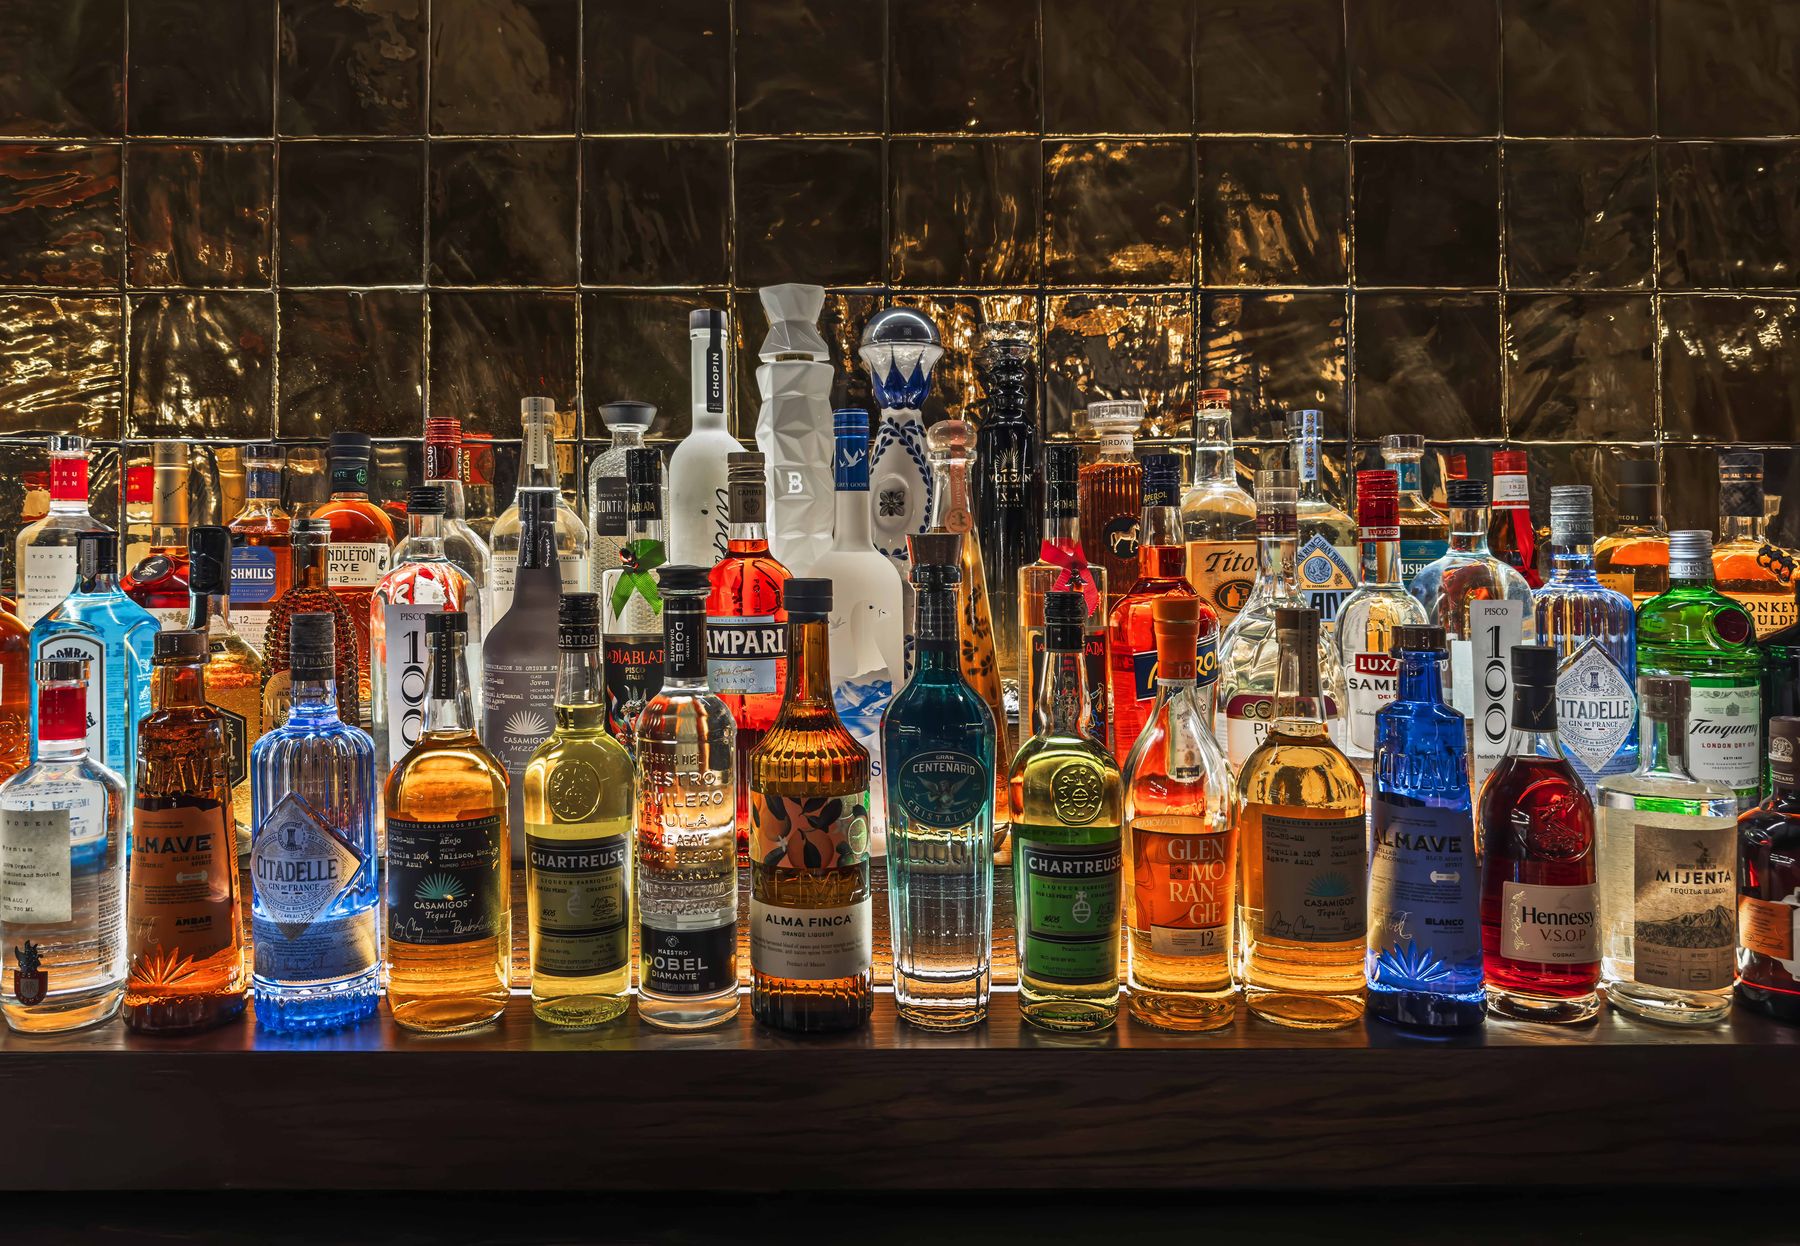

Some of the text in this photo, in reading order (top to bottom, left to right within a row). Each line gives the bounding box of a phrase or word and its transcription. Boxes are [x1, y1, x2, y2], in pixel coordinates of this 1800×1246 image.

[712, 352, 720, 398] CHOPIN
[787, 471, 803, 494] B
[1368, 527, 1399, 536] LUXARDO
[230, 567, 274, 580] SHMILLS
[330, 563, 360, 572] RYE
[339, 575, 349, 583] 12
[1483, 607, 1509, 616] PISCO
[239, 615, 249, 625] 12
[675, 621, 685, 673] DOBEL
[1591, 720, 1618, 728] FRANCE
[912, 761, 976, 776] CENTENARIO
[1167, 838, 1225, 861] GLEN
[530, 849, 625, 869] CHARTREUSE
[1027, 854, 1121, 875] CHARTREUSE
[257, 854, 339, 883] CITADELLE
[1191, 859, 1226, 881] MO
[1655, 868, 1733, 885] MIJENTA
[268, 883, 280, 891] GIN
[288, 883, 320, 892] FRANCE
[1169, 881, 1215, 903] RAN
[1669, 887, 1703, 895] TEQUILA
[413, 900, 468, 910] CASAMIGOS
[424, 911, 457, 921] Tequila
[765, 913, 852, 928] ALMA FINCA
[1189, 901, 1222, 925] GIE
[1521, 905, 1595, 928] Hennessy
[1199, 930, 1215, 947] 12
[657, 948, 689, 956] MAESTRO
[644, 952, 709, 971] DOBEL
[651, 969, 698, 981] DIAMANTE
